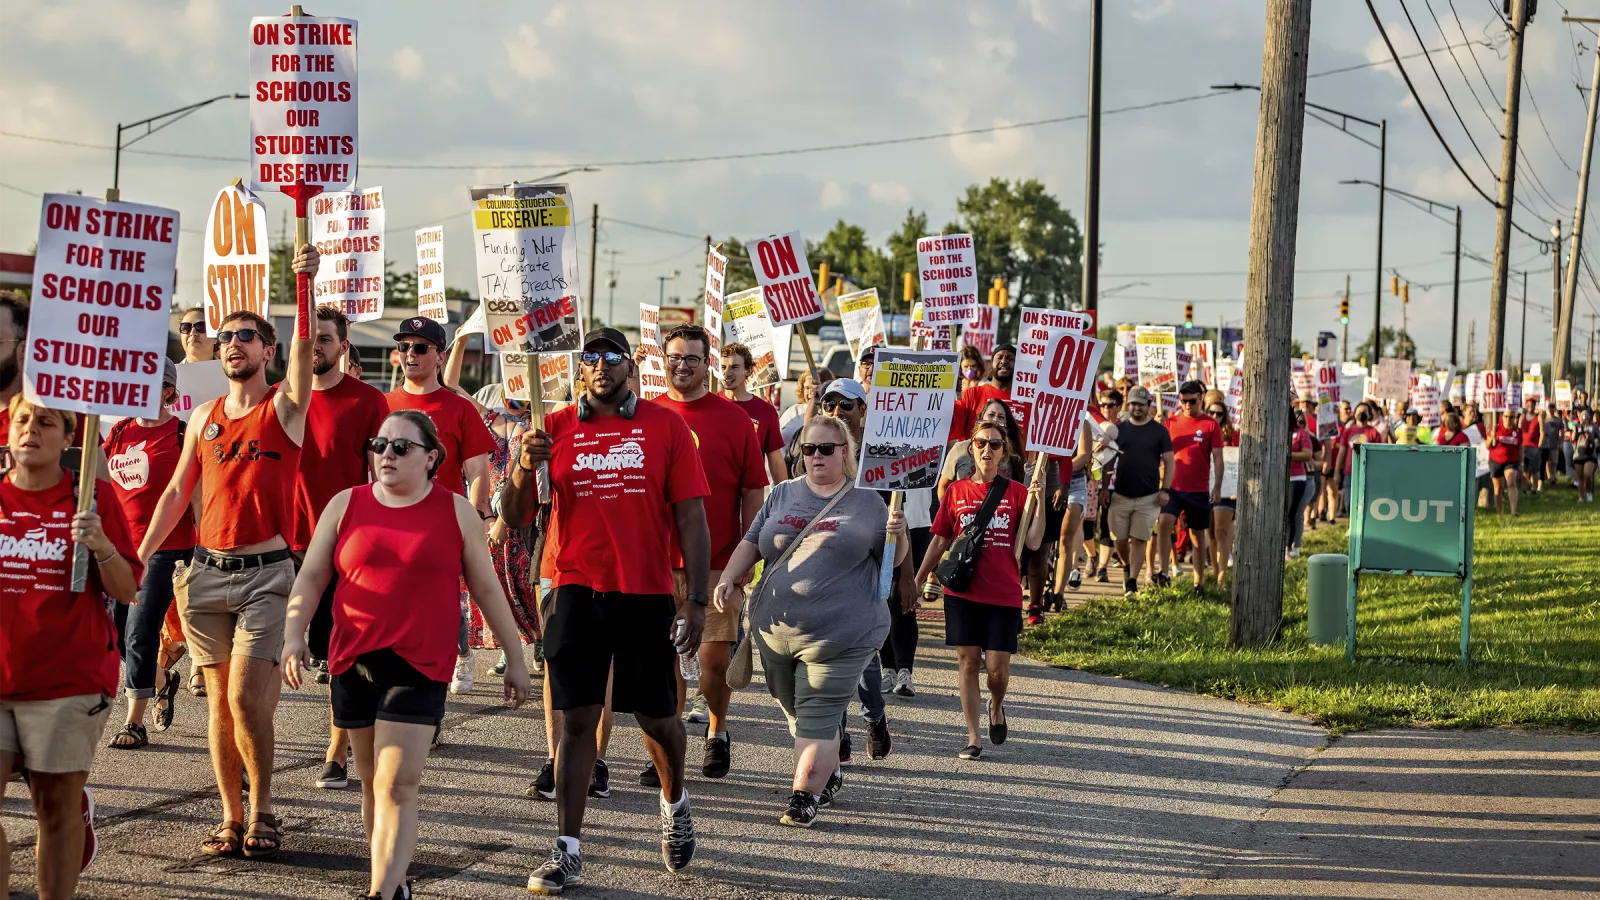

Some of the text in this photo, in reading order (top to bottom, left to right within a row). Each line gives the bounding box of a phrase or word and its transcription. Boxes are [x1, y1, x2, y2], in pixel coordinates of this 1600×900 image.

[253, 23, 352, 46] ON STRIKE
[272, 54, 335, 73] FOR THE
[256, 80, 351, 103] SCHOOLS
[286, 109, 319, 128] OUR
[254, 135, 354, 156] STUDENTS
[260, 163, 348, 184] DESERVE!
[314, 191, 381, 216] ON STRIKE
[486, 197, 556, 210] COLUMBUS STUDENTS
[46, 202, 173, 243] ON STRIKE
[213, 190, 257, 257] ON
[347, 217, 369, 231] THE
[491, 208, 553, 229] DESERVE:
[316, 235, 380, 256] SCHOOLS
[425, 248, 436, 258] THE
[482, 233, 556, 262] Funding Not
[919, 237, 971, 253] ON STRIKE
[66, 243, 147, 273] FOR THE
[335, 259, 357, 273] OUR
[757, 236, 800, 280] ON
[929, 253, 963, 266] FOR THE
[922, 266, 972, 281] SCHOOLS
[42, 273, 163, 311] SCHOOLS
[207, 263, 266, 331] STRIKE
[315, 276, 381, 297] STUDENTS
[939, 282, 957, 293] OUR
[764, 276, 822, 323] STRIKE
[924, 293, 975, 308] STUDENTS
[78, 313, 120, 338] OUR
[493, 296, 575, 346] ON STRIKE
[928, 308, 974, 322] DESERVE!
[1023, 311, 1081, 330] ON STRIKE
[932, 340, 951, 350] HERE
[1031, 329, 1049, 341] FOR
[33, 338, 159, 375] STUDENTS
[1048, 335, 1095, 392] ON
[1144, 346, 1168, 360] SAFE
[1190, 343, 1208, 363] ON
[507, 355, 568, 393] ON RIKE
[888, 363, 946, 373] COLUMBUS STUDENTS
[1319, 367, 1337, 384] ON
[36, 372, 150, 408] DESERVE!
[890, 372, 941, 388] DESERVE:
[1486, 373, 1503, 389] ON
[875, 392, 944, 411] HEAT IN
[1483, 392, 1507, 409] STRIKE
[875, 416, 942, 439] JANUARY
[1030, 391, 1085, 450] STRIKE
[110, 456, 142, 471] Union
[864, 445, 940, 483] ON STRIKE
[1369, 497, 1454, 523] OUT
